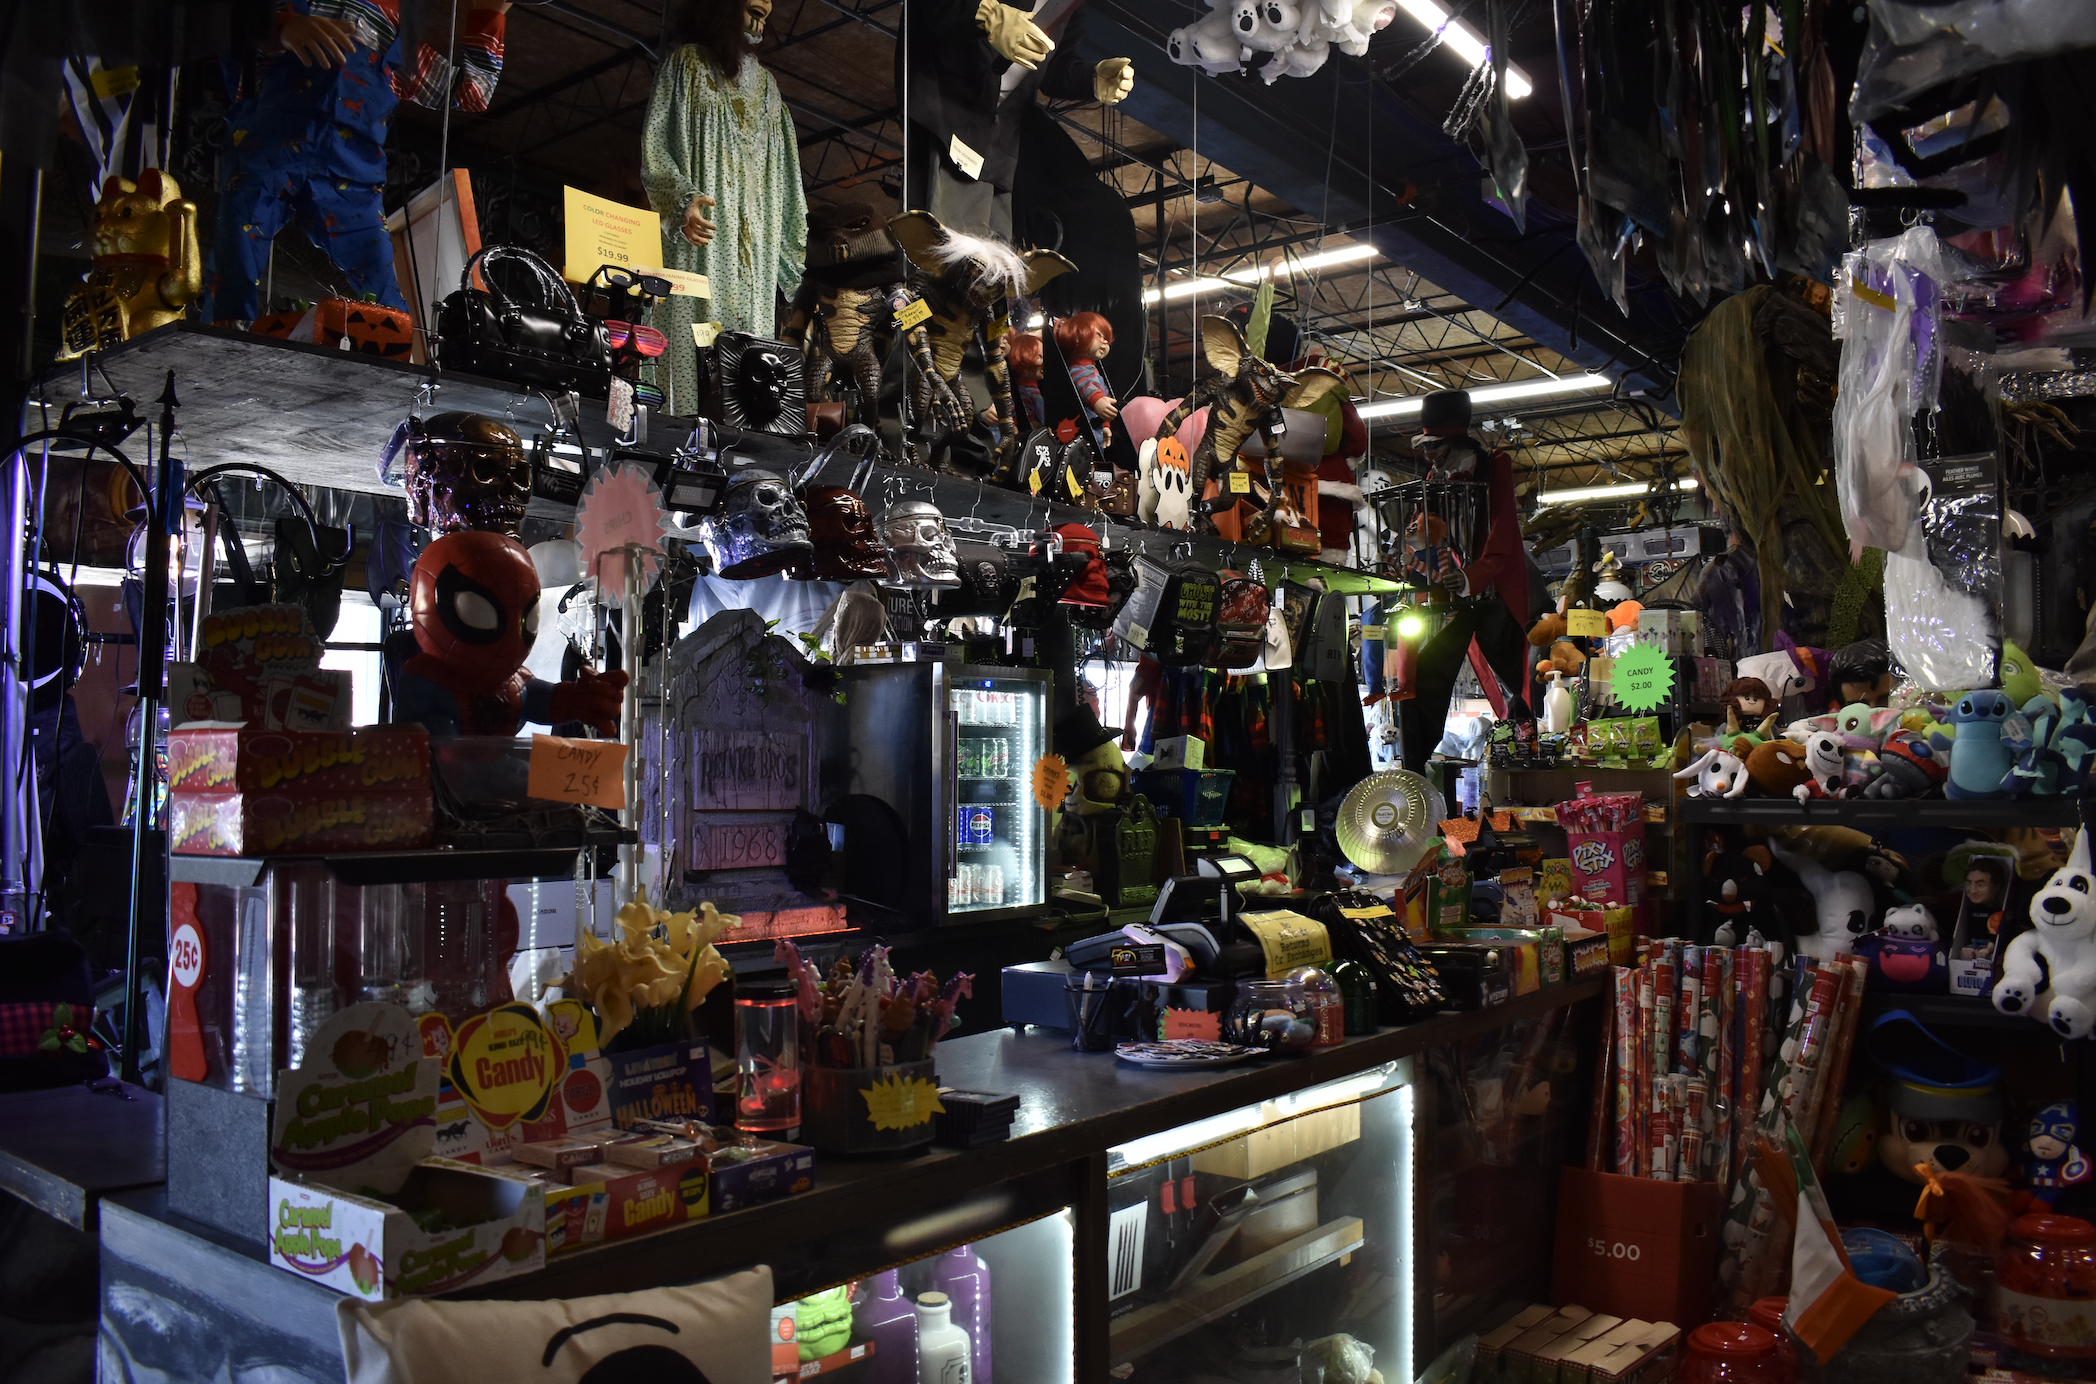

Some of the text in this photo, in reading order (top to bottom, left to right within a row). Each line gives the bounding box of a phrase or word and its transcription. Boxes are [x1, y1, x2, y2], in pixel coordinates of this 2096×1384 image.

[583, 204, 641, 227] COLOR CHANGING
[592, 218, 604, 227] LED
[605, 223, 633, 235] GLASSES
[597, 246, 629, 262] $19.99
[686, 276, 708, 285] GLASSES
[1966, 472, 1983, 480] PLUMES
[1180, 582, 1215, 601] GHOST
[1179, 598, 1213, 610] WITH THE
[1177, 607, 1213, 622] MOST!
[203, 607, 302, 648] BUBBLE
[254, 634, 311, 663] GUM
[1326, 648, 1342, 660] RIP
[1627, 667, 1654, 678] CANDY
[1630, 681, 1653, 691] $2.00
[170, 741, 235, 788] BUBBLE GUM
[259, 738, 421, 788] BUBBLE GUM
[557, 745, 602, 770] CANDY
[759, 744, 798, 788] BROS
[1043, 766, 1061, 780] DRINKS
[563, 773, 599, 796] 25¢
[1040, 790, 1053, 801] $1.00
[261, 795, 425, 850] BUBBLE GUM
[970, 821, 991, 829] PEPSI
[722, 828, 778, 863] 1968
[1121, 828, 1156, 852] RIP
[1578, 911, 1584, 920] 6
[1279, 921, 1292, 930] No
[1279, 928, 1310, 942] Refunds
[1280, 939, 1311, 952] Returns
[174, 939, 199, 971] 25¢
[1274, 947, 1324, 965] Or Exchanges
[1957, 976, 1984, 989] BLUTO
[1488, 988, 1508, 1001] MYSTERY
[488, 1039, 524, 1052] KING SIZE
[476, 1047, 545, 1090] Candy
[620, 1066, 687, 1088] HOLIDAY LOLLIPOP
[297, 1060, 419, 1117] Caramel
[563, 1081, 601, 1102] TARGET
[573, 1111, 600, 1121] CANDY
[616, 1091, 697, 1130] HALLOWEEN
[281, 1095, 436, 1150] Apple Pops
[439, 1145, 468, 1156] CANDY
[561, 1151, 595, 1164] CANDY
[637, 1178, 657, 1191] KING
[682, 1187, 702, 1198] RECIPE
[639, 1190, 655, 1200] SIZE
[279, 1199, 334, 1230] Caramel
[623, 1186, 676, 1227] Candy
[274, 1226, 342, 1263] Apple Pops
[400, 1229, 475, 1273] Caramel
[1587, 1236, 1641, 1261] $5.00
[391, 1249, 488, 1298] Apple Pops
[799, 1367, 821, 1379] WARS
[800, 1361, 821, 1371] STAR
